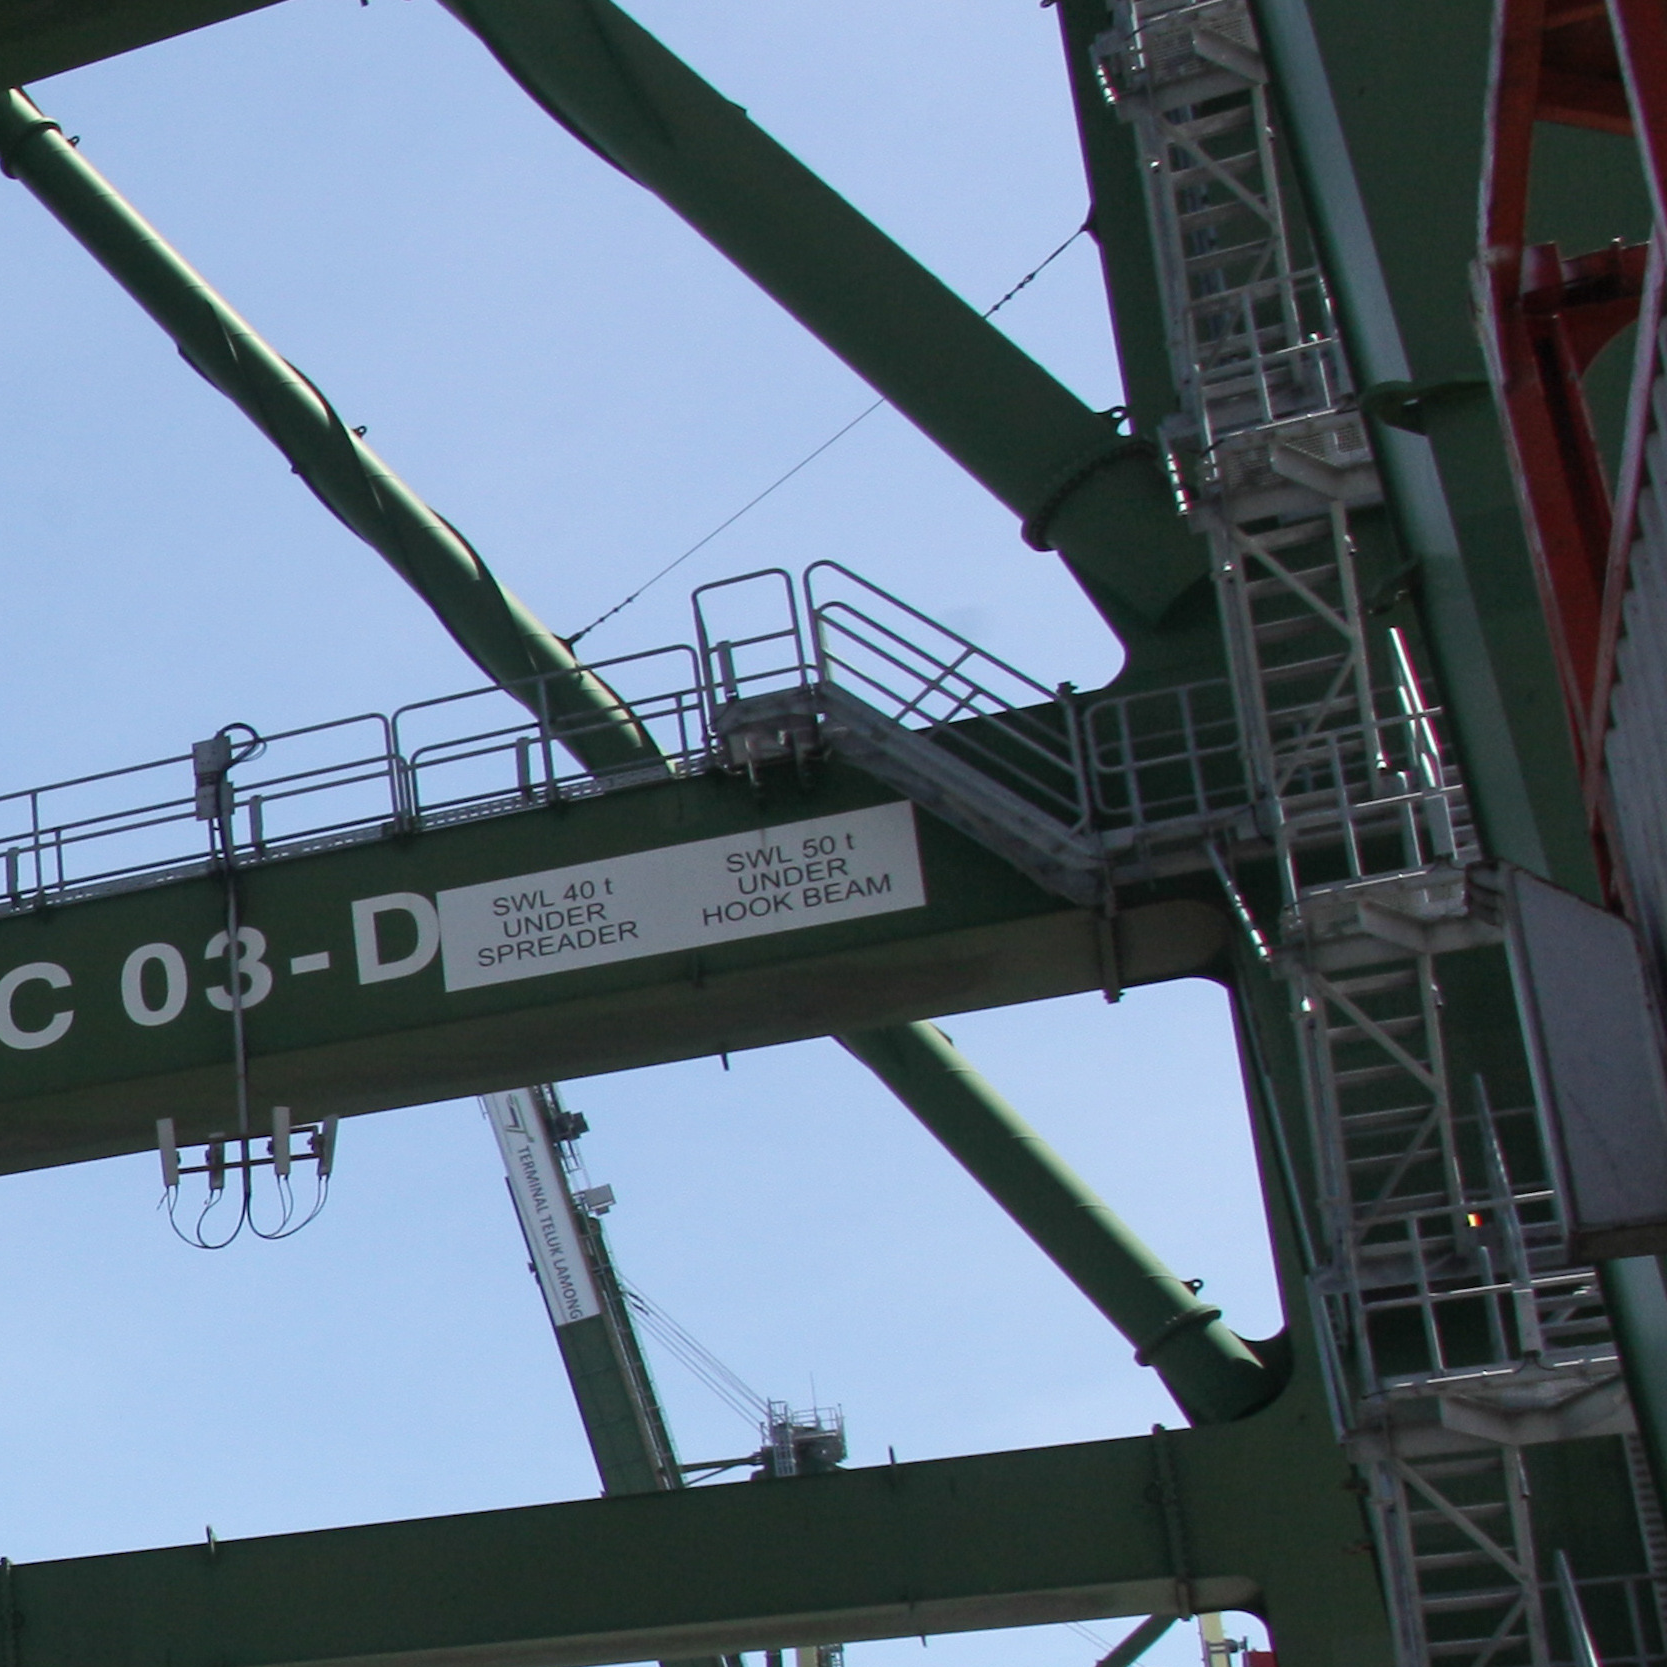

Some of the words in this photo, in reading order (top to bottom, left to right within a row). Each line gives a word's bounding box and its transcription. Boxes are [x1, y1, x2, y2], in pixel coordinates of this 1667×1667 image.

[726, 845, 792, 874] SWL
[802, 835, 835, 859] 50
[845, 832, 855, 851] t
[493, 891, 556, 917] SWL
[563, 880, 596, 902] 40
[603, 877, 614, 896] t
[738, 857, 848, 896] UNDER
[503, 902, 607, 938] UNDER
[702, 891, 792, 927] HOOK
[803, 873, 892, 909] BEAM
[120, 891, 441, 1027] 03-D
[478, 920, 640, 967] SPREADER
[518, 1145, 544, 1215] TERMINAL
[540, 1214, 562, 1257] TELUK
[553, 1255, 584, 1320] LAMONG
